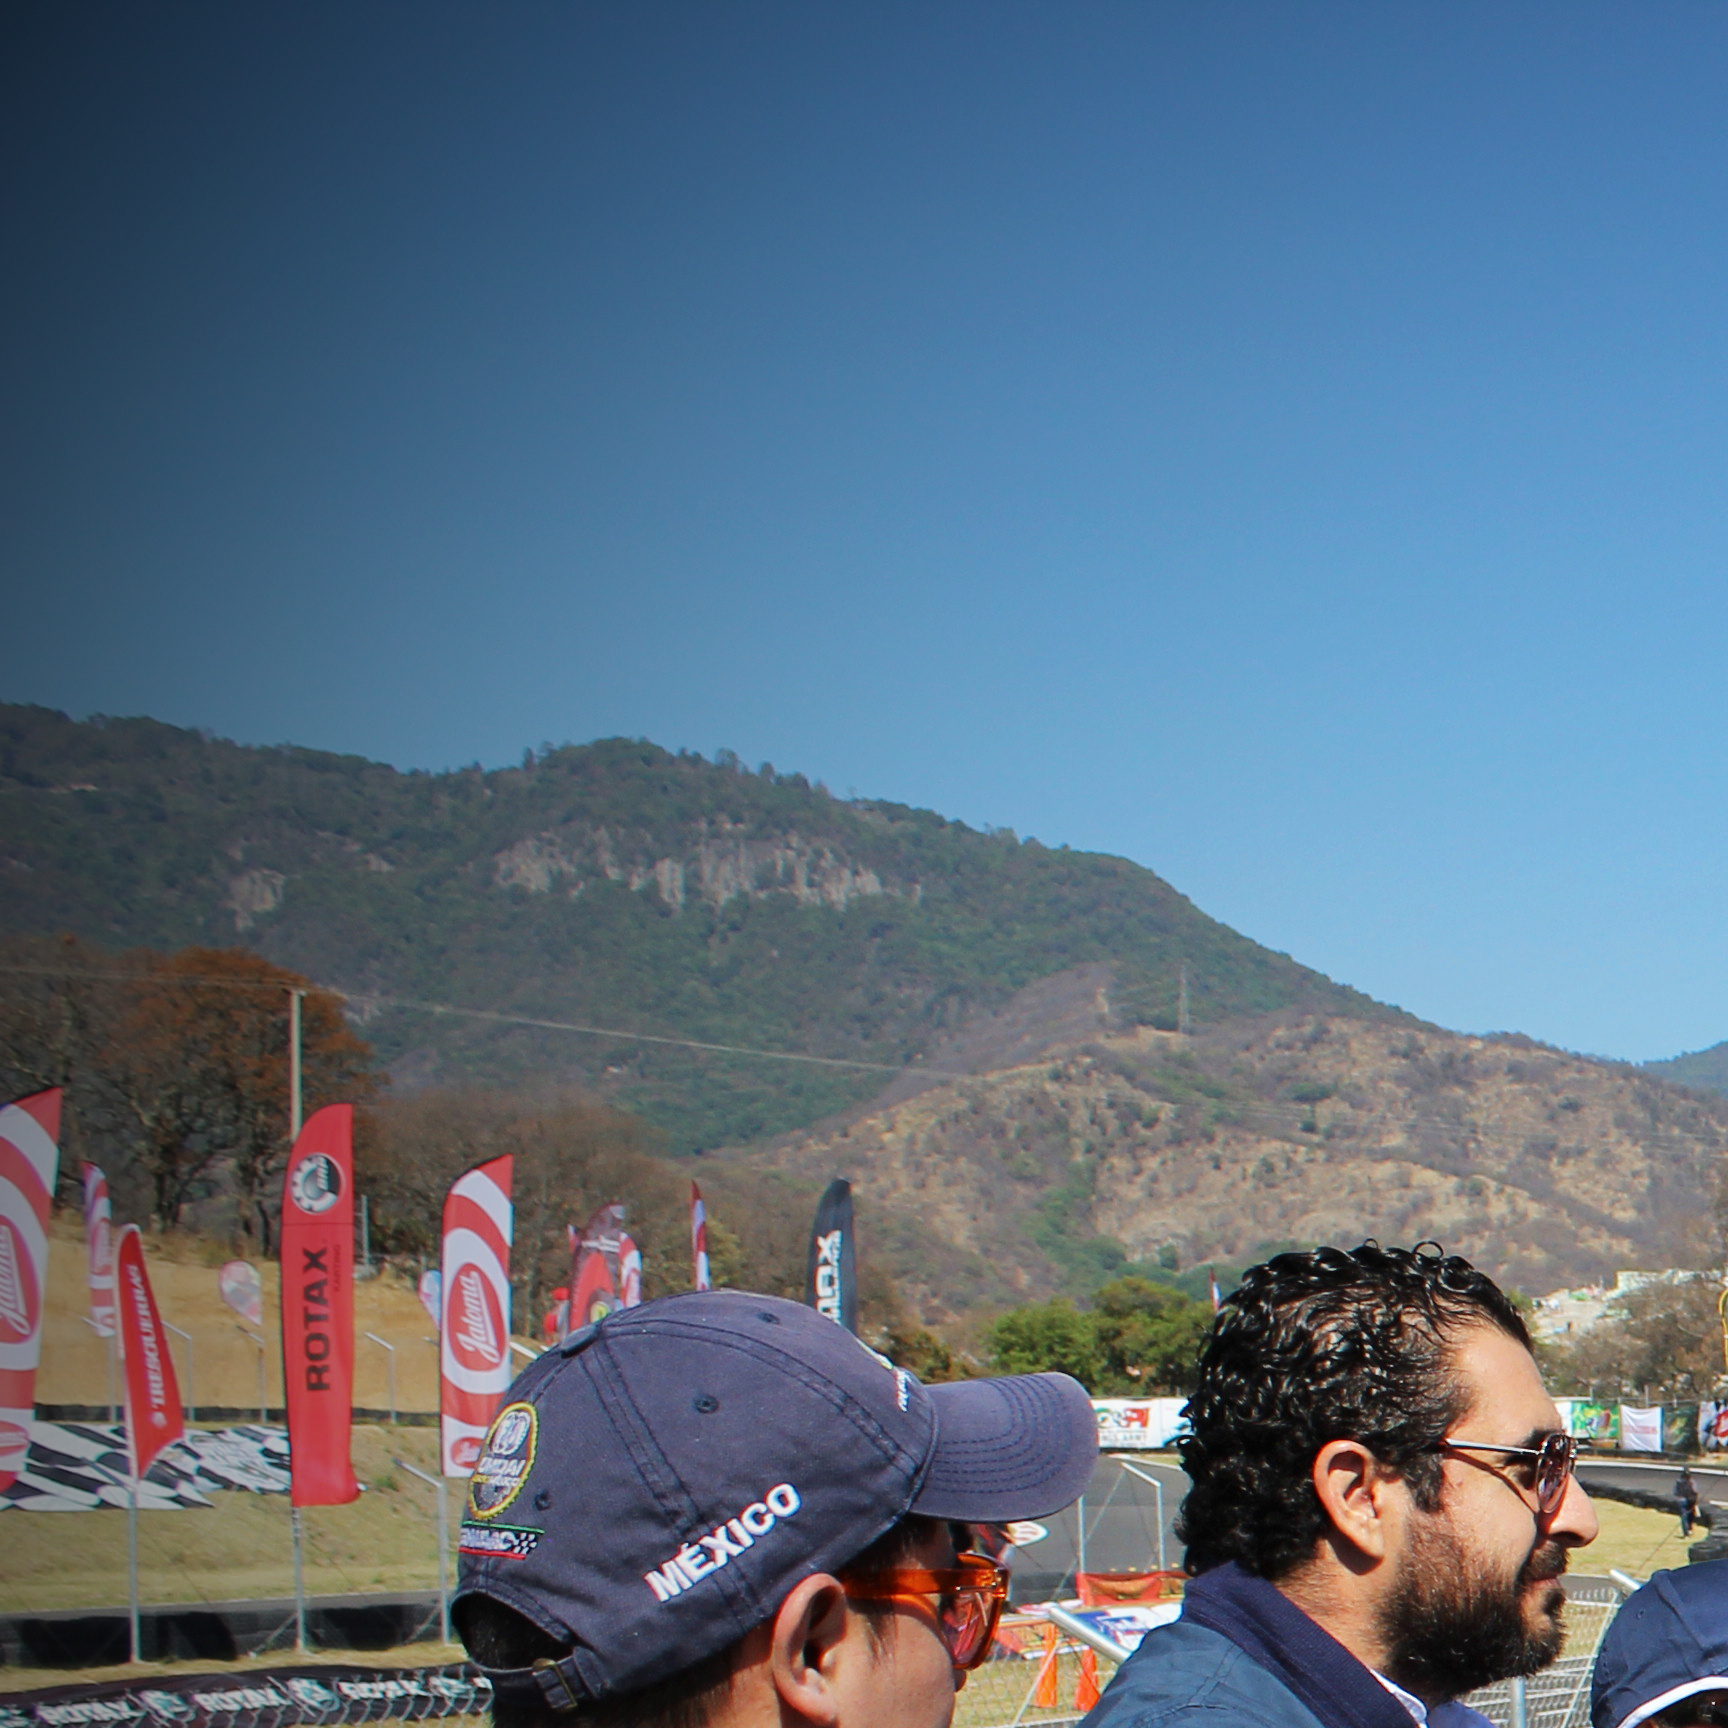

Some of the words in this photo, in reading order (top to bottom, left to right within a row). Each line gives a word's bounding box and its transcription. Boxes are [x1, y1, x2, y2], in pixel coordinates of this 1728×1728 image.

[129, 1263, 166, 1409] TRESGUERRAS
[302, 1246, 330, 1392] ROTAX
[457, 1270, 502, 1365] Jaloma
[643, 1481, 802, 1603] MÉXICO
[36, 1697, 144, 1726] ROTAX
[191, 1686, 292, 1715] ROTAX
